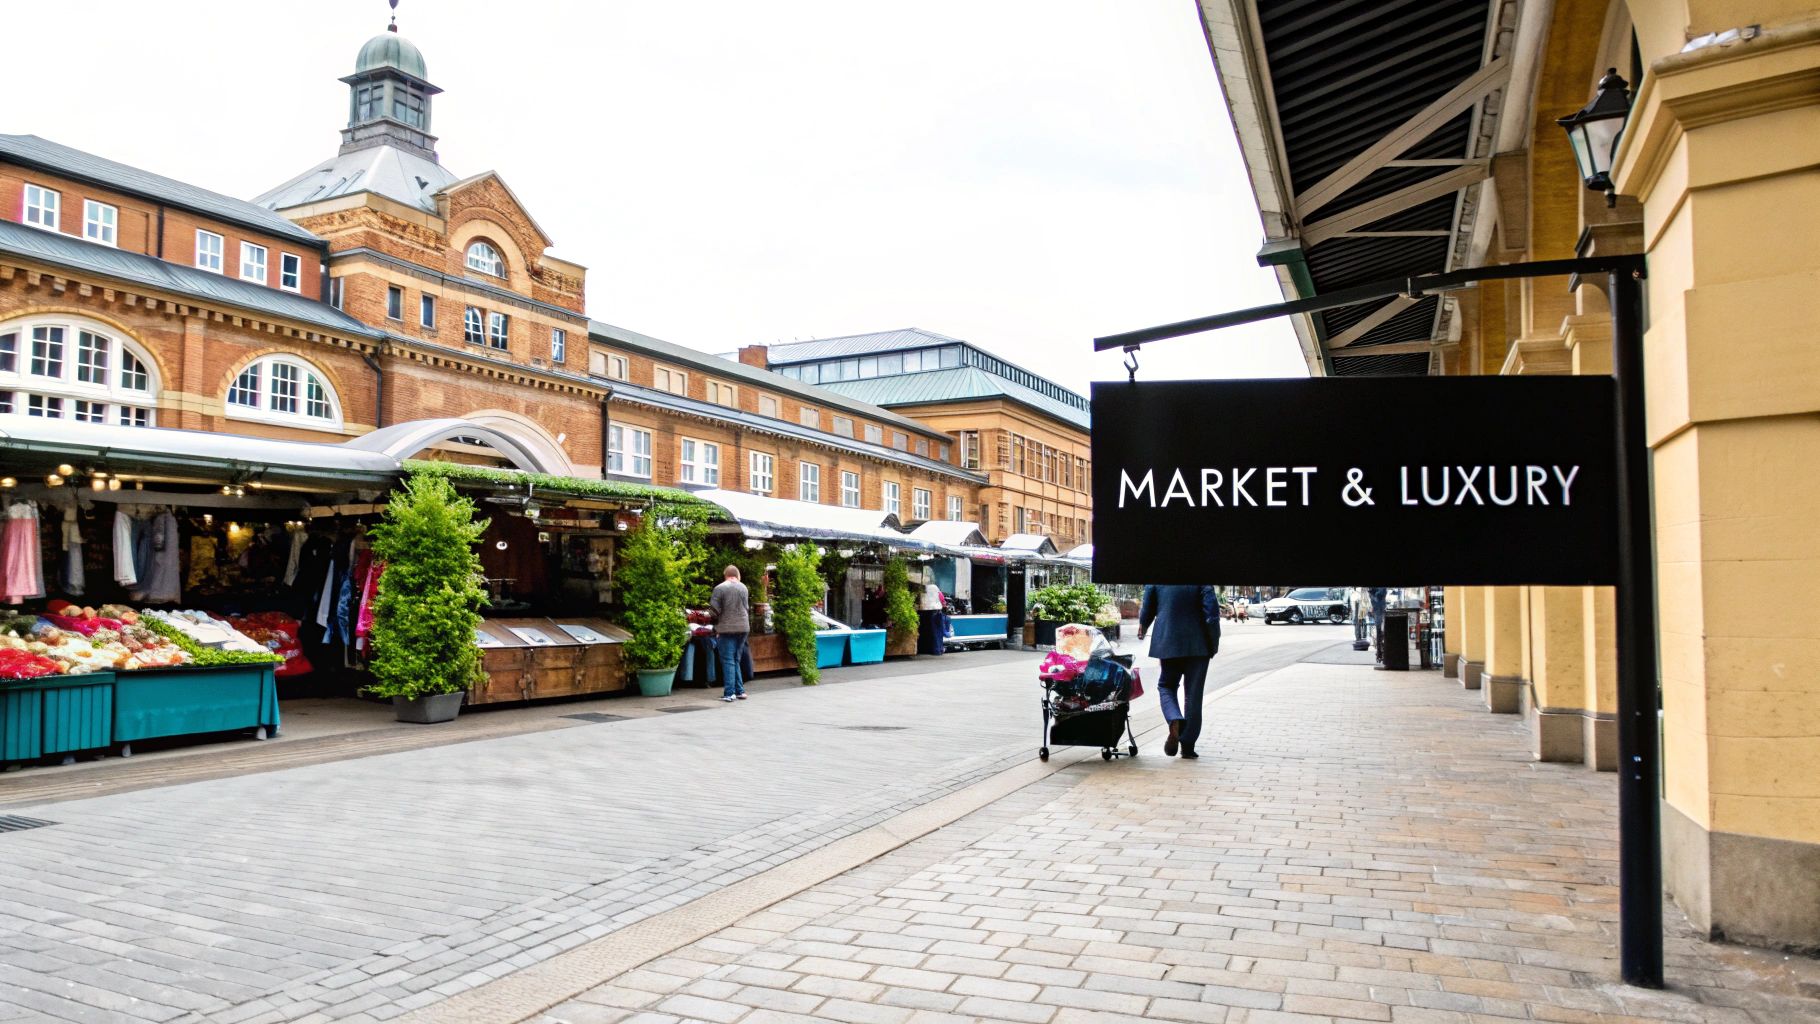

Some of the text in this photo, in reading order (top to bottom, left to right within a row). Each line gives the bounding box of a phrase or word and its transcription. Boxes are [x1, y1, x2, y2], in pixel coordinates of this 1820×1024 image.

[1118, 465, 1580, 508] MARKET & LUXURY
